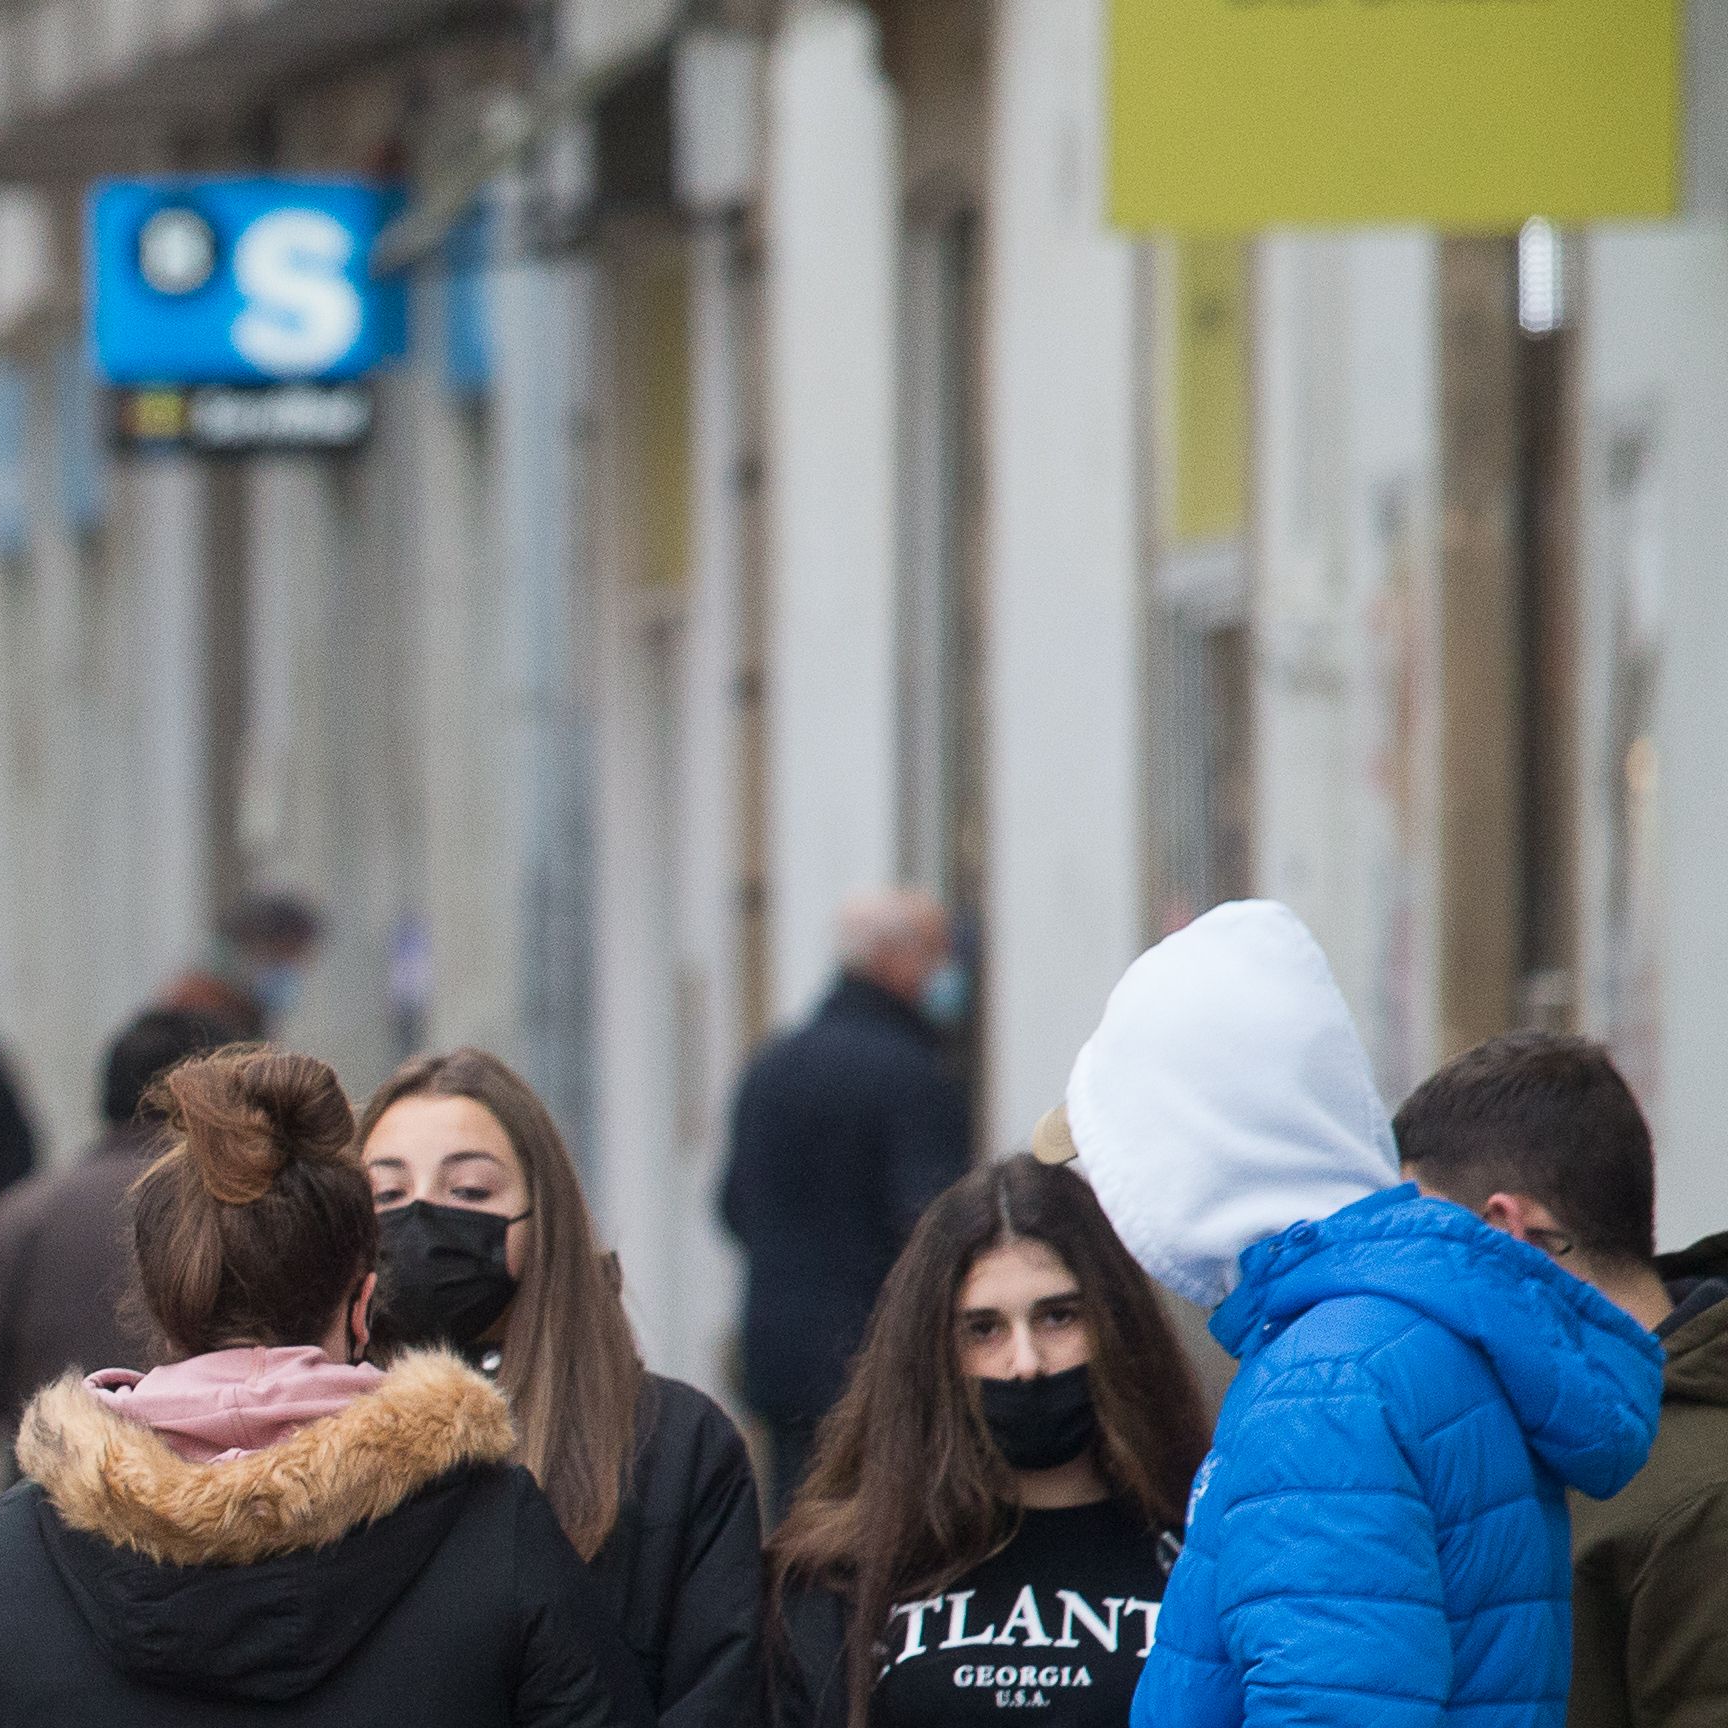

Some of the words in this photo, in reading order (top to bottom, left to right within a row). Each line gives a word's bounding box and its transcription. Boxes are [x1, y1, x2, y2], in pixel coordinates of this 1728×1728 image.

[231, 207, 364, 377] S
[876, 1584, 1163, 1681] TLANT
[953, 1664, 1093, 1688] GEORGIA
[995, 1689, 1051, 1708] U.S.A.
